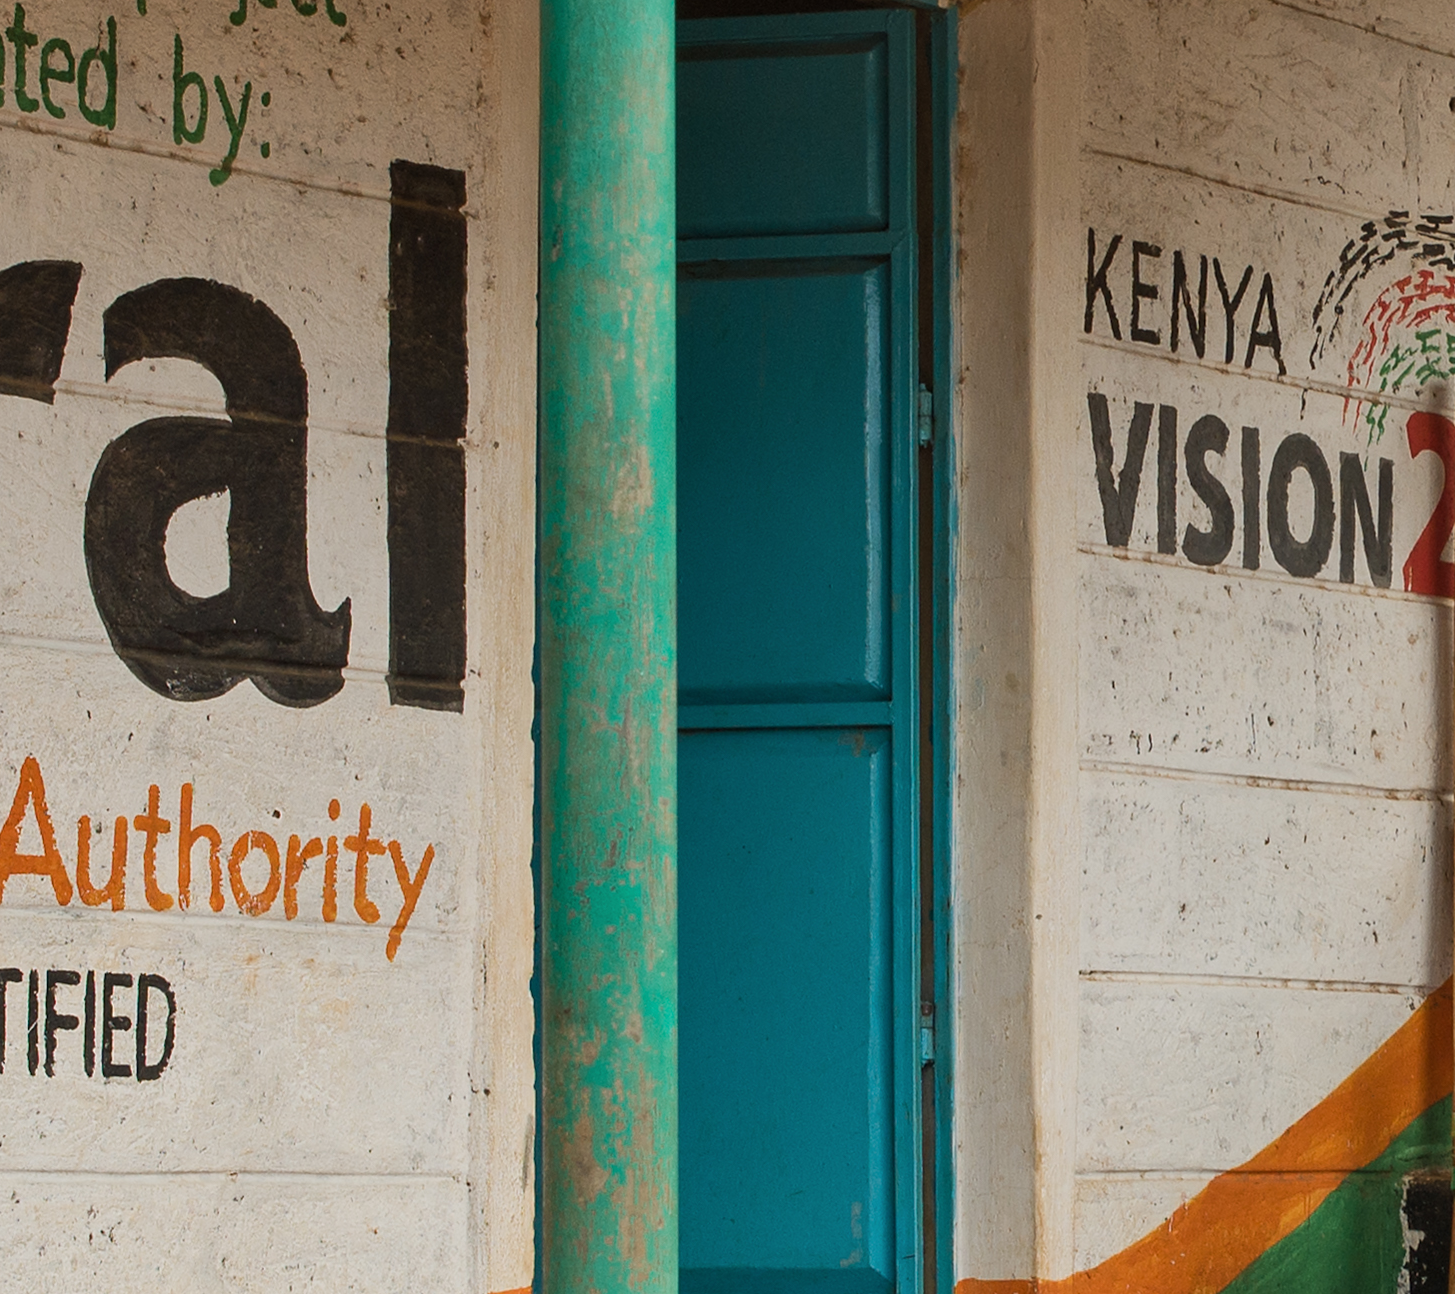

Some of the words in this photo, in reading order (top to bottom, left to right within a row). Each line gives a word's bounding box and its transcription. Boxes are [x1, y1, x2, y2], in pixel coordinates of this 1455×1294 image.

[173, 33, 272, 187] by:
[1083, 226, 1288, 376] KENYA
[1086, 391, 1395, 591] VISION
